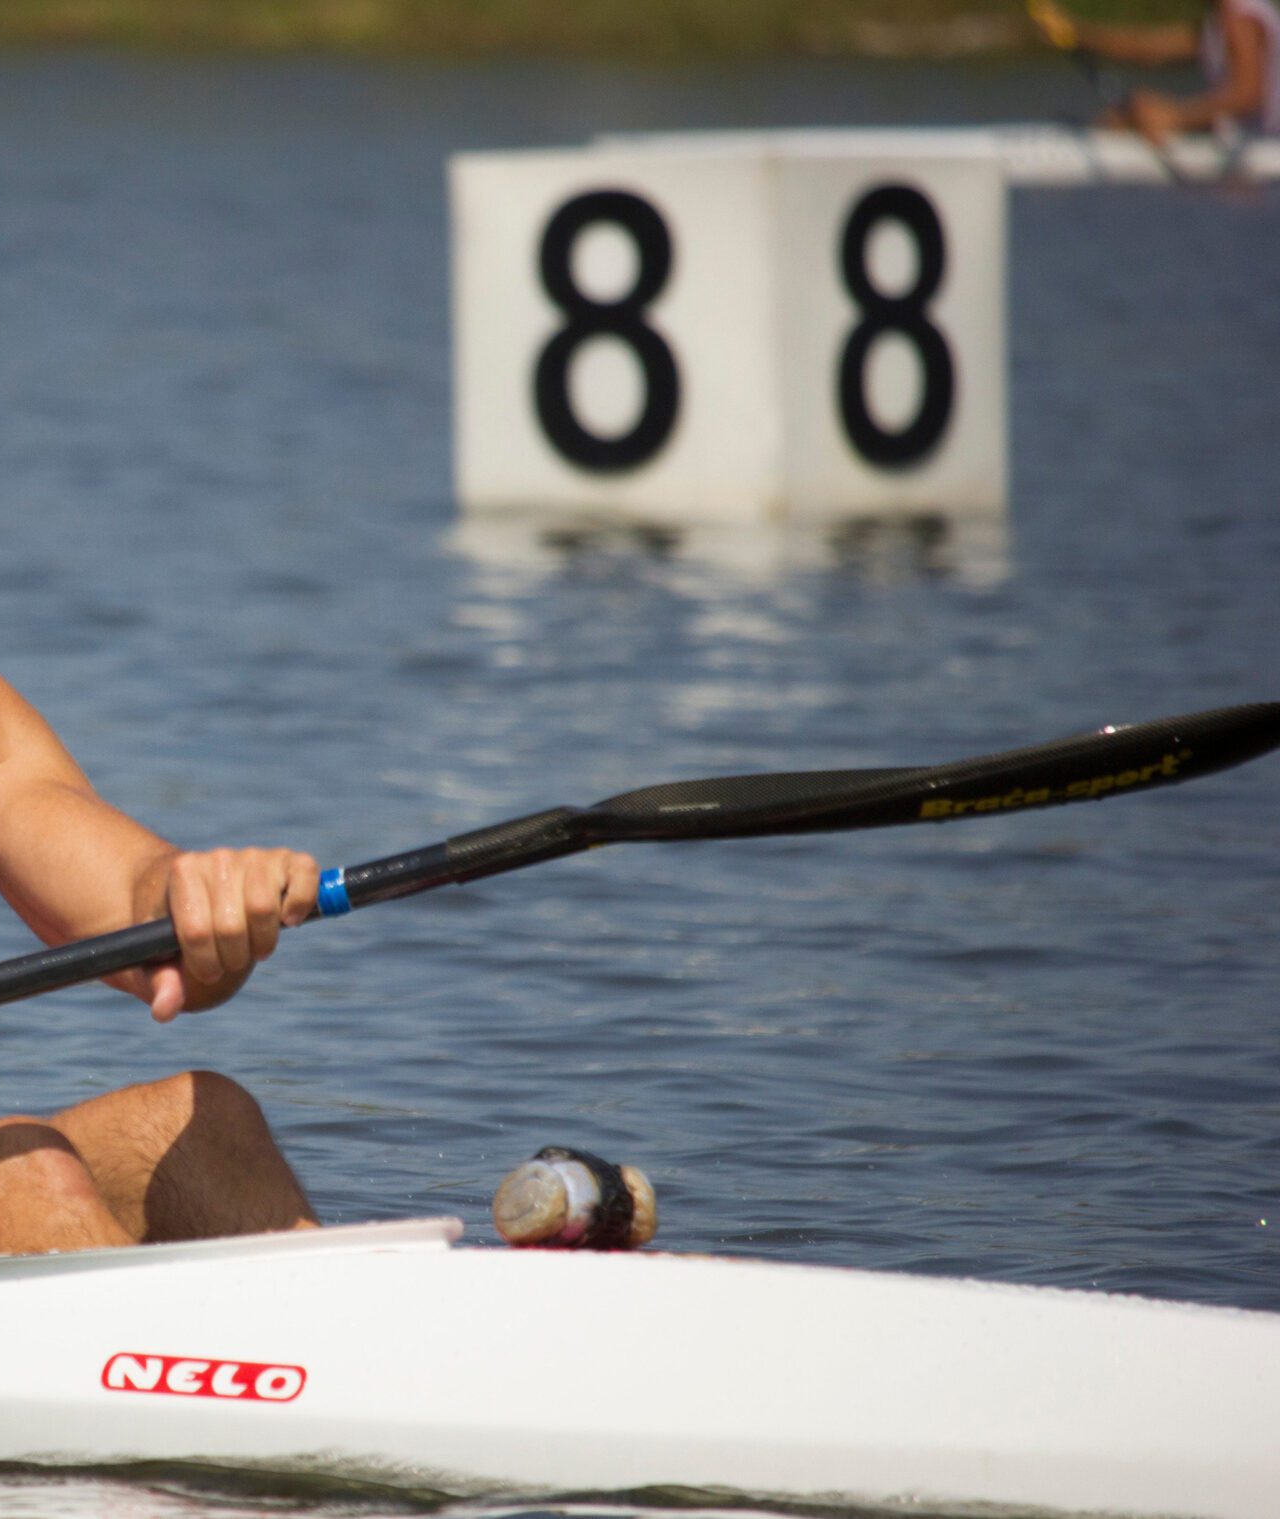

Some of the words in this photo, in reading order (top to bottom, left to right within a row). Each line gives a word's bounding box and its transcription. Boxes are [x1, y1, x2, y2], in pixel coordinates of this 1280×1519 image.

[532, 187, 682, 476] 8
[837, 182, 958, 473] 8
[106, 1354, 304, 1400] NELO
